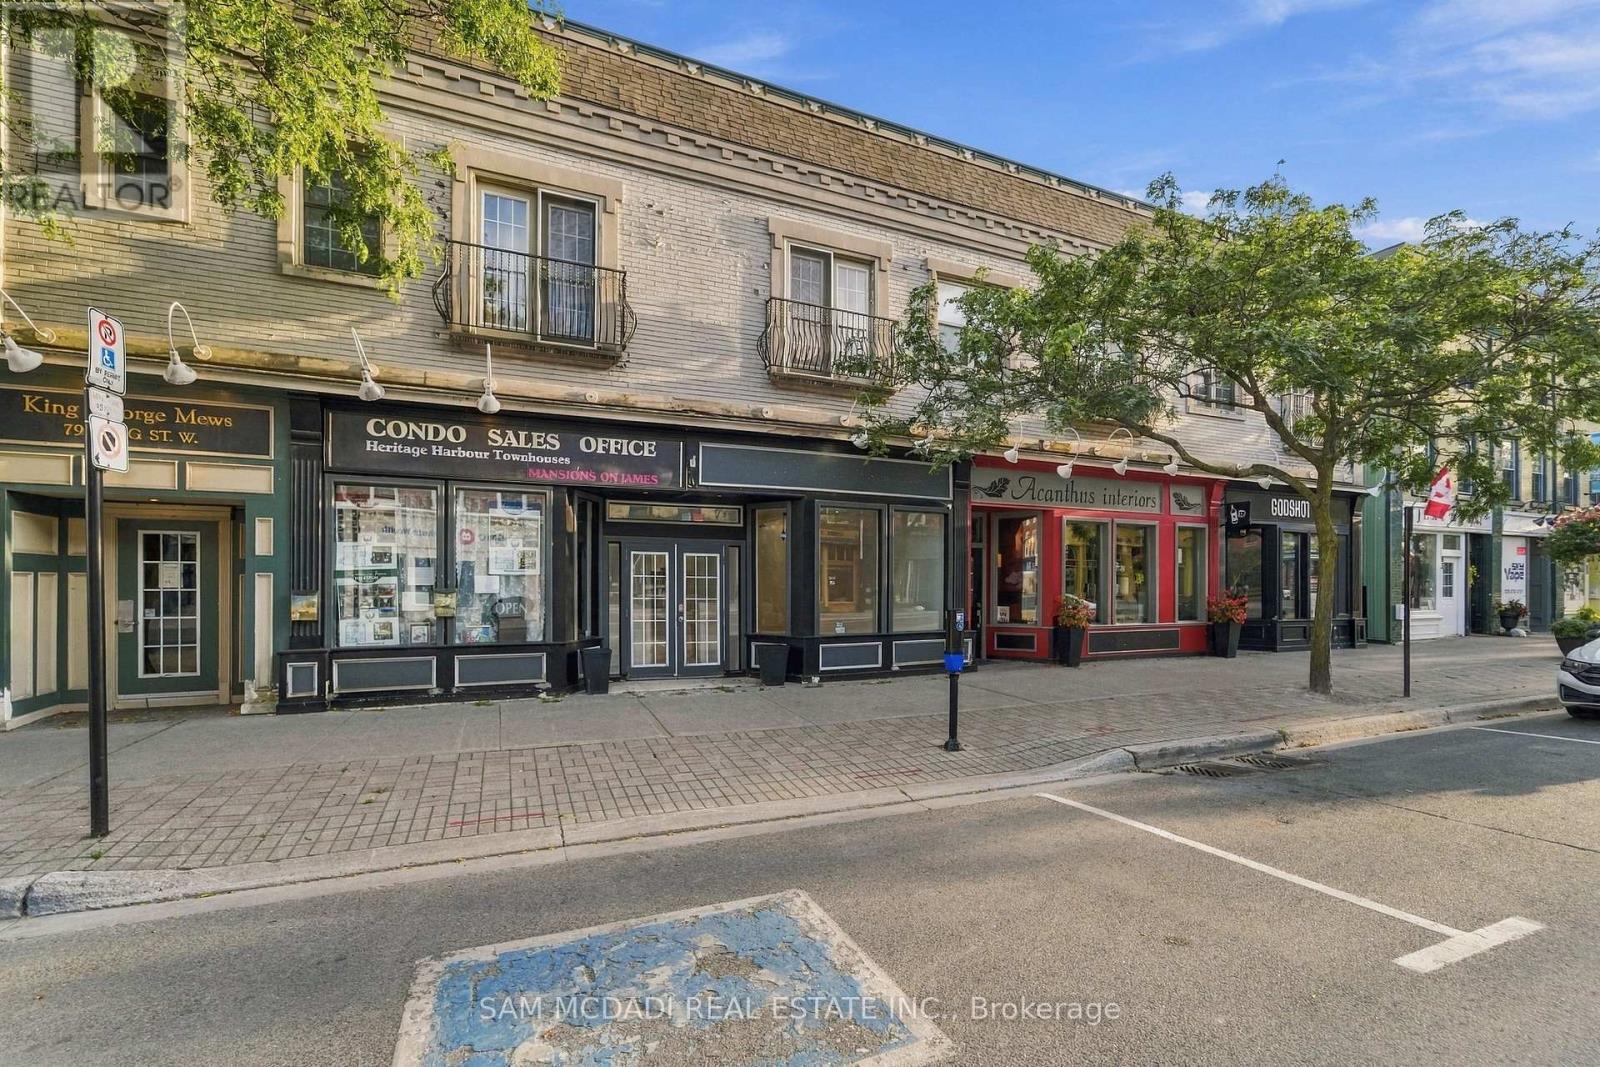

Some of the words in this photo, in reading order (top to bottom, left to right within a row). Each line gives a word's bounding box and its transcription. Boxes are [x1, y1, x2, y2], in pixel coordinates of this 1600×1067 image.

[22, 395, 80, 419] King
[123, 409, 167, 424] orge
[175, 407, 233, 427] Mews
[366, 418, 467, 443] CONDO
[487, 428, 561, 451] SALES
[579, 436, 657, 457] OFFICE
[365, 440, 428, 458] Heritage
[431, 445, 490, 460] Harbour
[492, 449, 571, 465] Townhouses
[600, 472, 618, 483] ON
[620, 473, 659, 484] JAMES
[1011, 475, 1096, 505] Acanthus
[1102, 487, 1157, 508] interiors
[495, 601, 528, 617] OPEN
